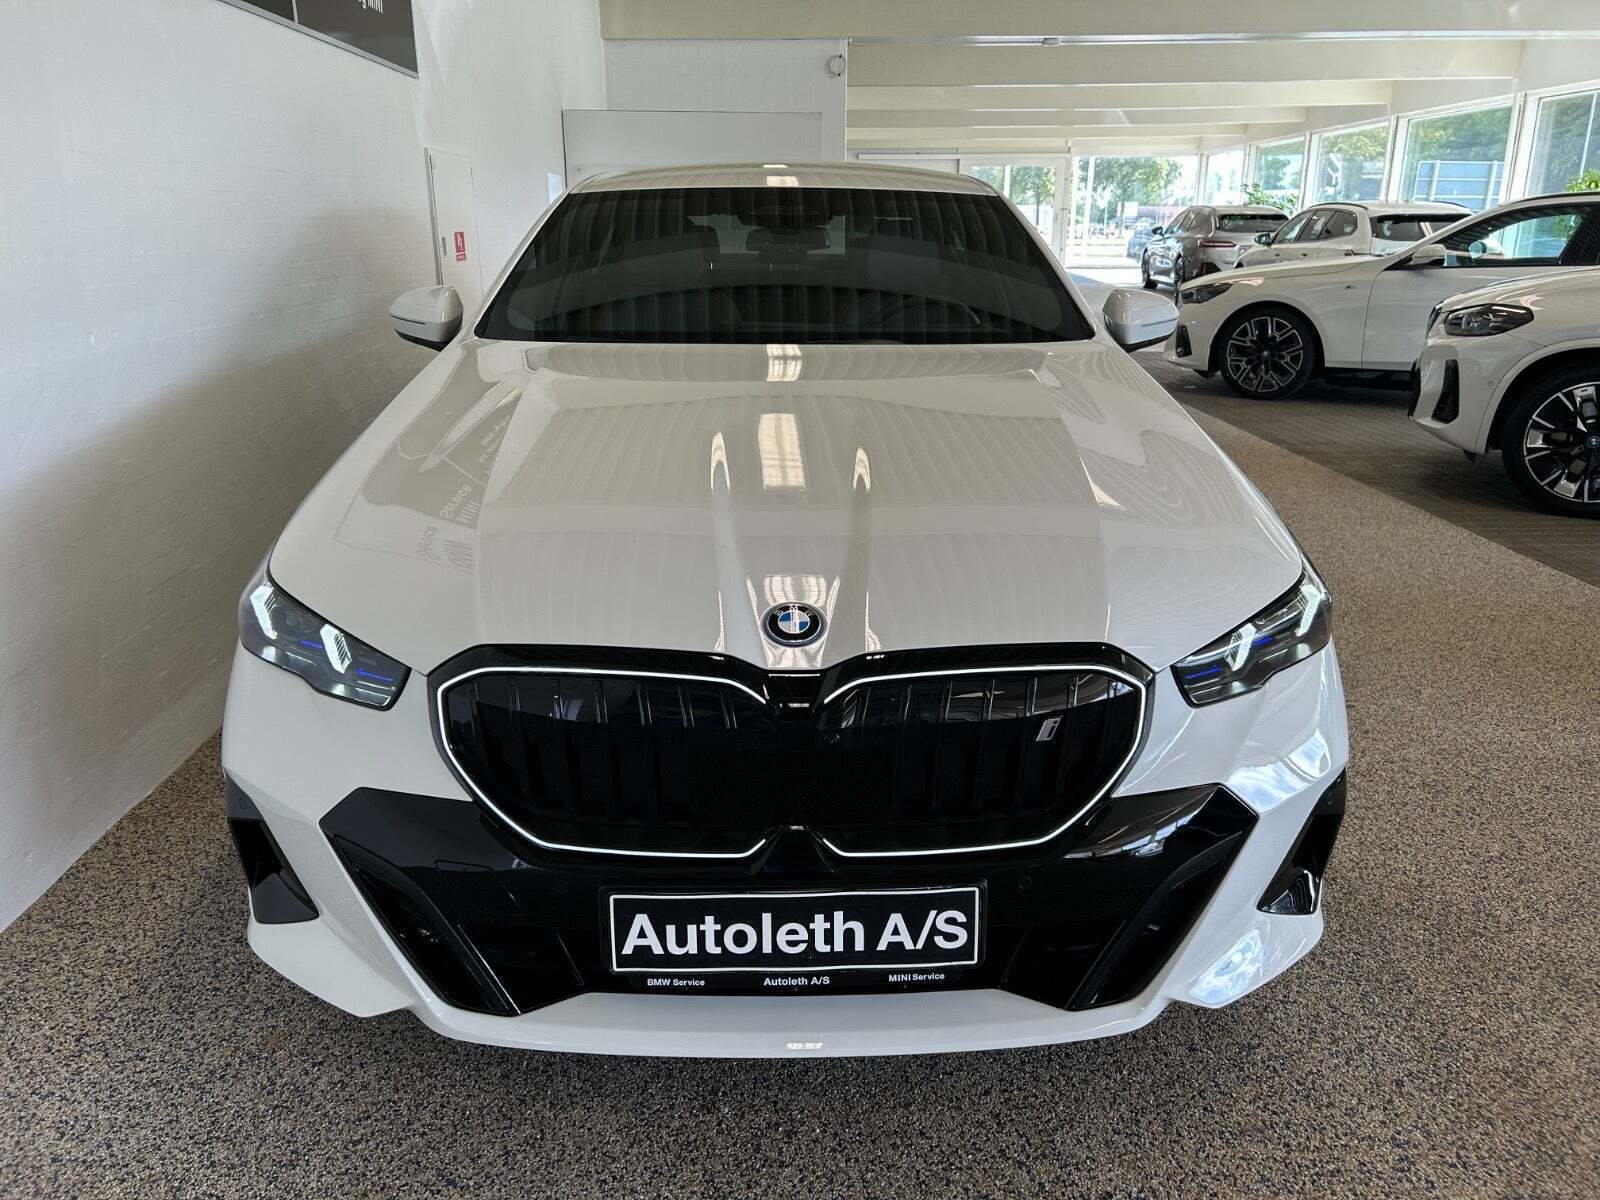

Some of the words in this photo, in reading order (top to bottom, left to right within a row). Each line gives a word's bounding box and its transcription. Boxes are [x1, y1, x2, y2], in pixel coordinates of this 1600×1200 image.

[621, 911, 865, 955] Autoleth
[876, 910, 968, 951] A/S
[647, 978, 671, 986] BMW
[673, 978, 705, 986] Service
[763, 977, 808, 986] Autoleth
[810, 976, 830, 985] A/S
[888, 974, 911, 982] MINI
[912, 973, 945, 981] Service
